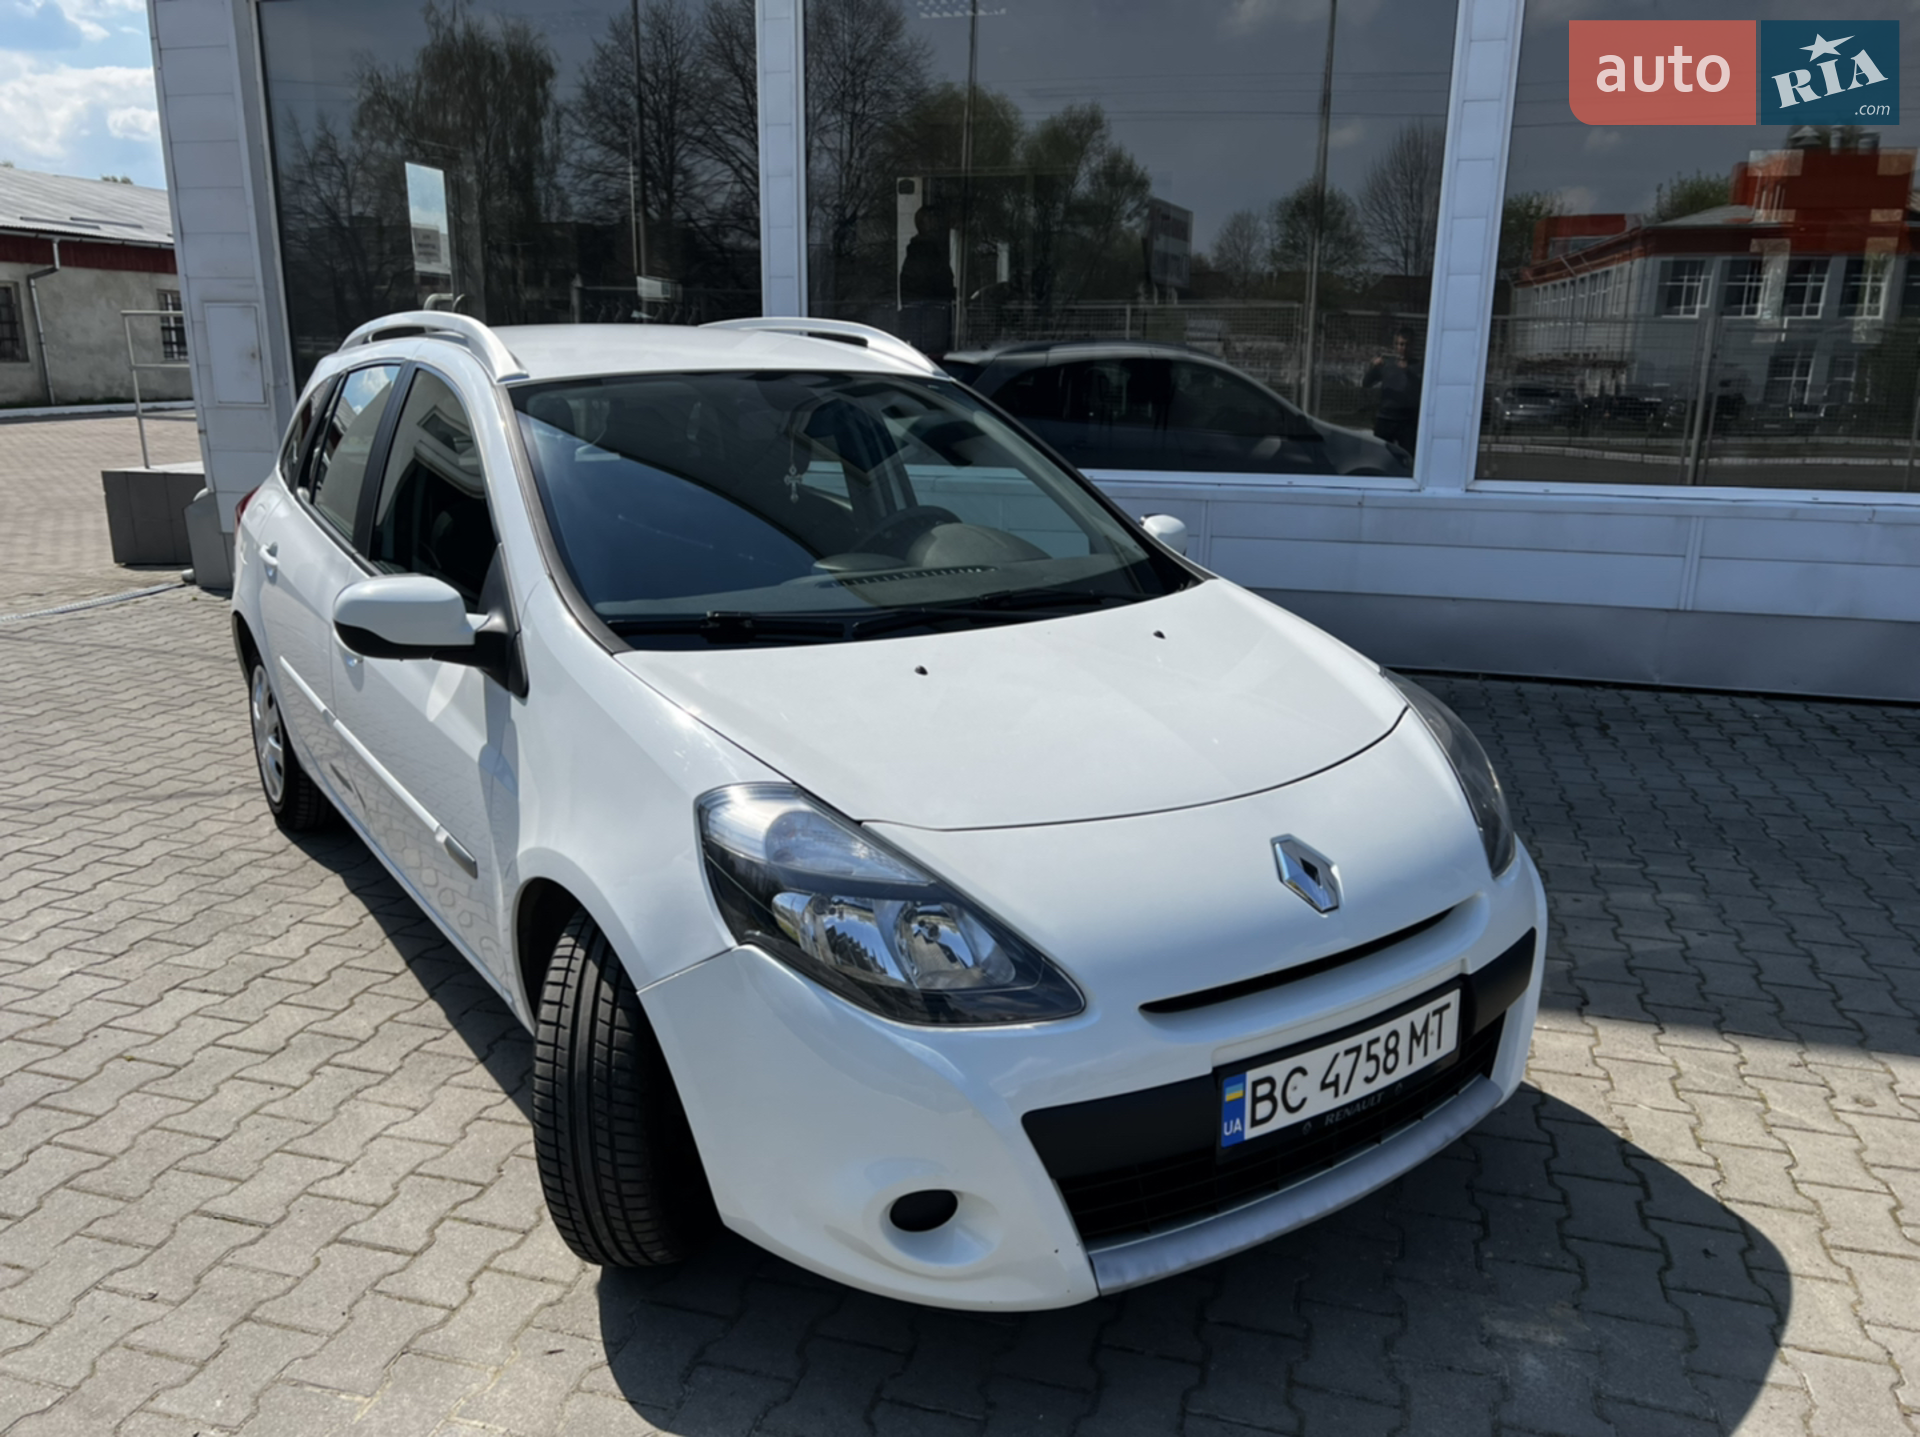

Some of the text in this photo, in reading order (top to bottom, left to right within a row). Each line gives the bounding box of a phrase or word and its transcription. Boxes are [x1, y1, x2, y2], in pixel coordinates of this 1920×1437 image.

[1249, 1002, 1452, 1130] BC 4758 MT
[1223, 1117, 1242, 1136] UA
[1324, 1091, 1385, 1127] RENAULT
